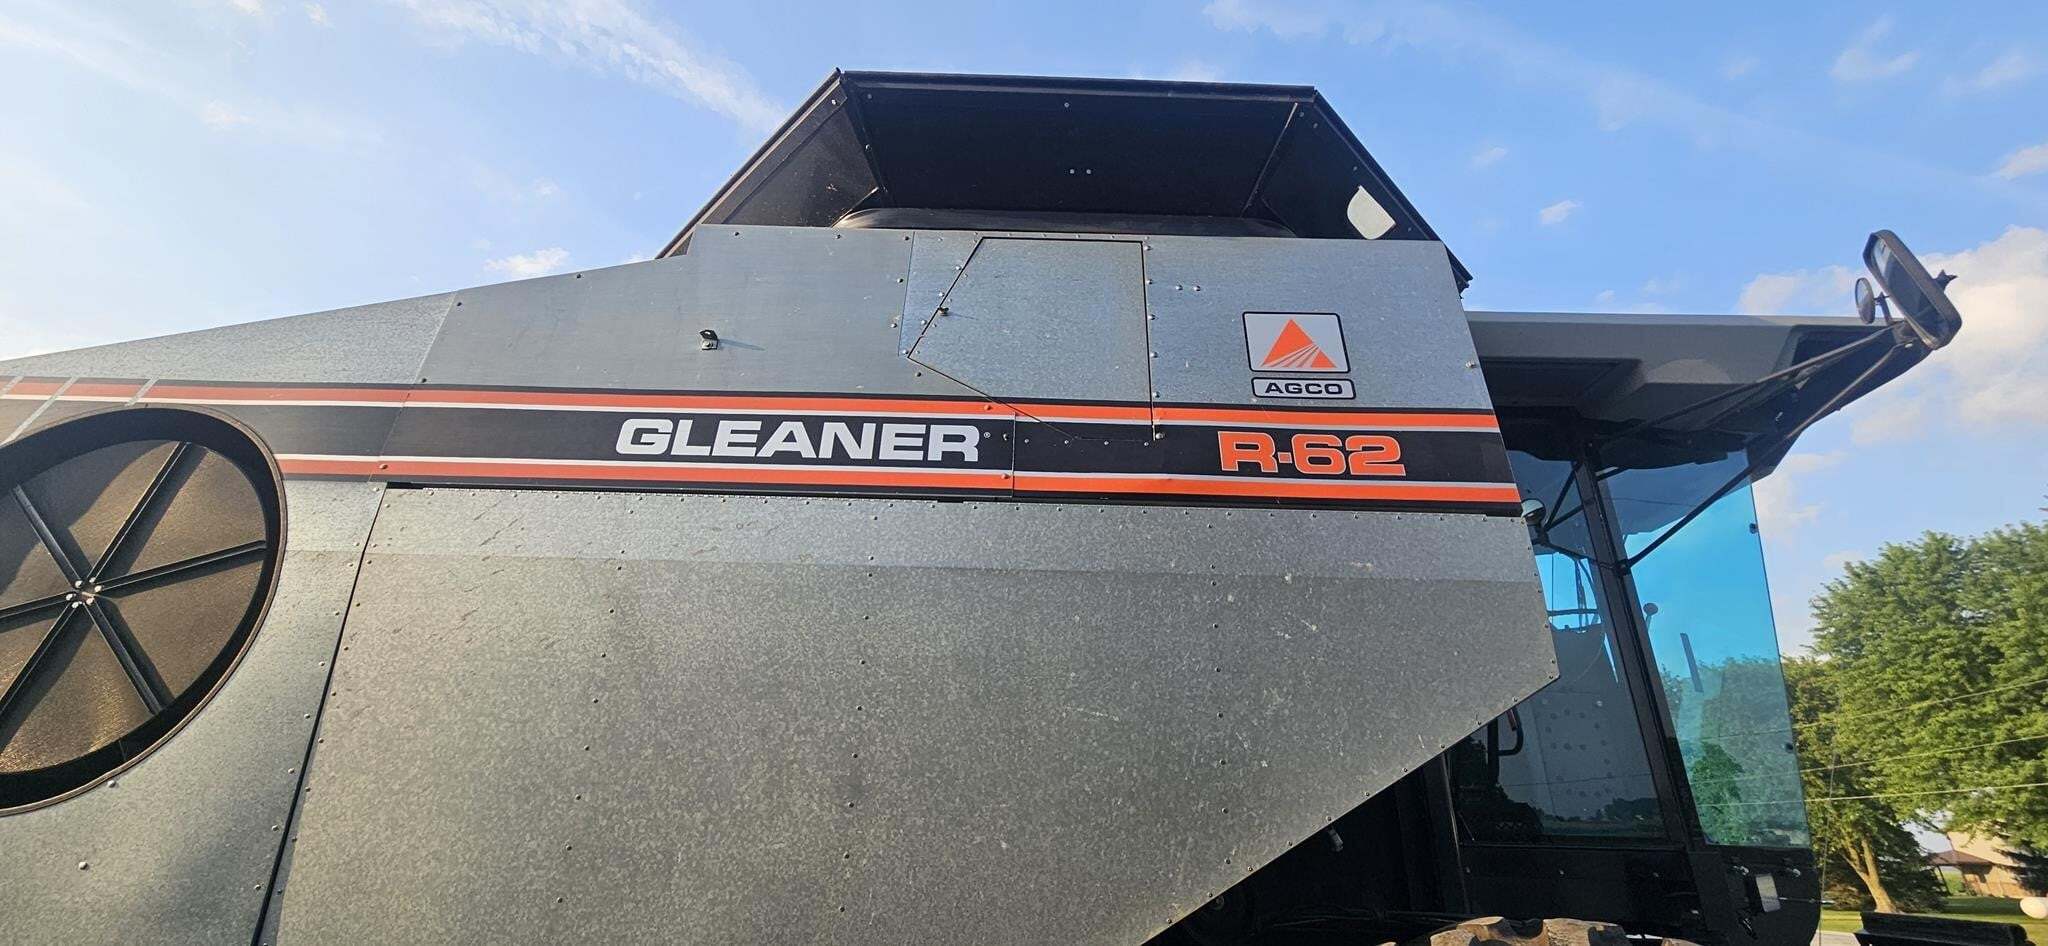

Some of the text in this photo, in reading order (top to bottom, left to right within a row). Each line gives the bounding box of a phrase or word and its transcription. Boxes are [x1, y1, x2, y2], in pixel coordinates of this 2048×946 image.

[1264, 382, 1343, 395] AGCO
[615, 418, 981, 462] GLEANER
[1217, 430, 1407, 476] R-62
